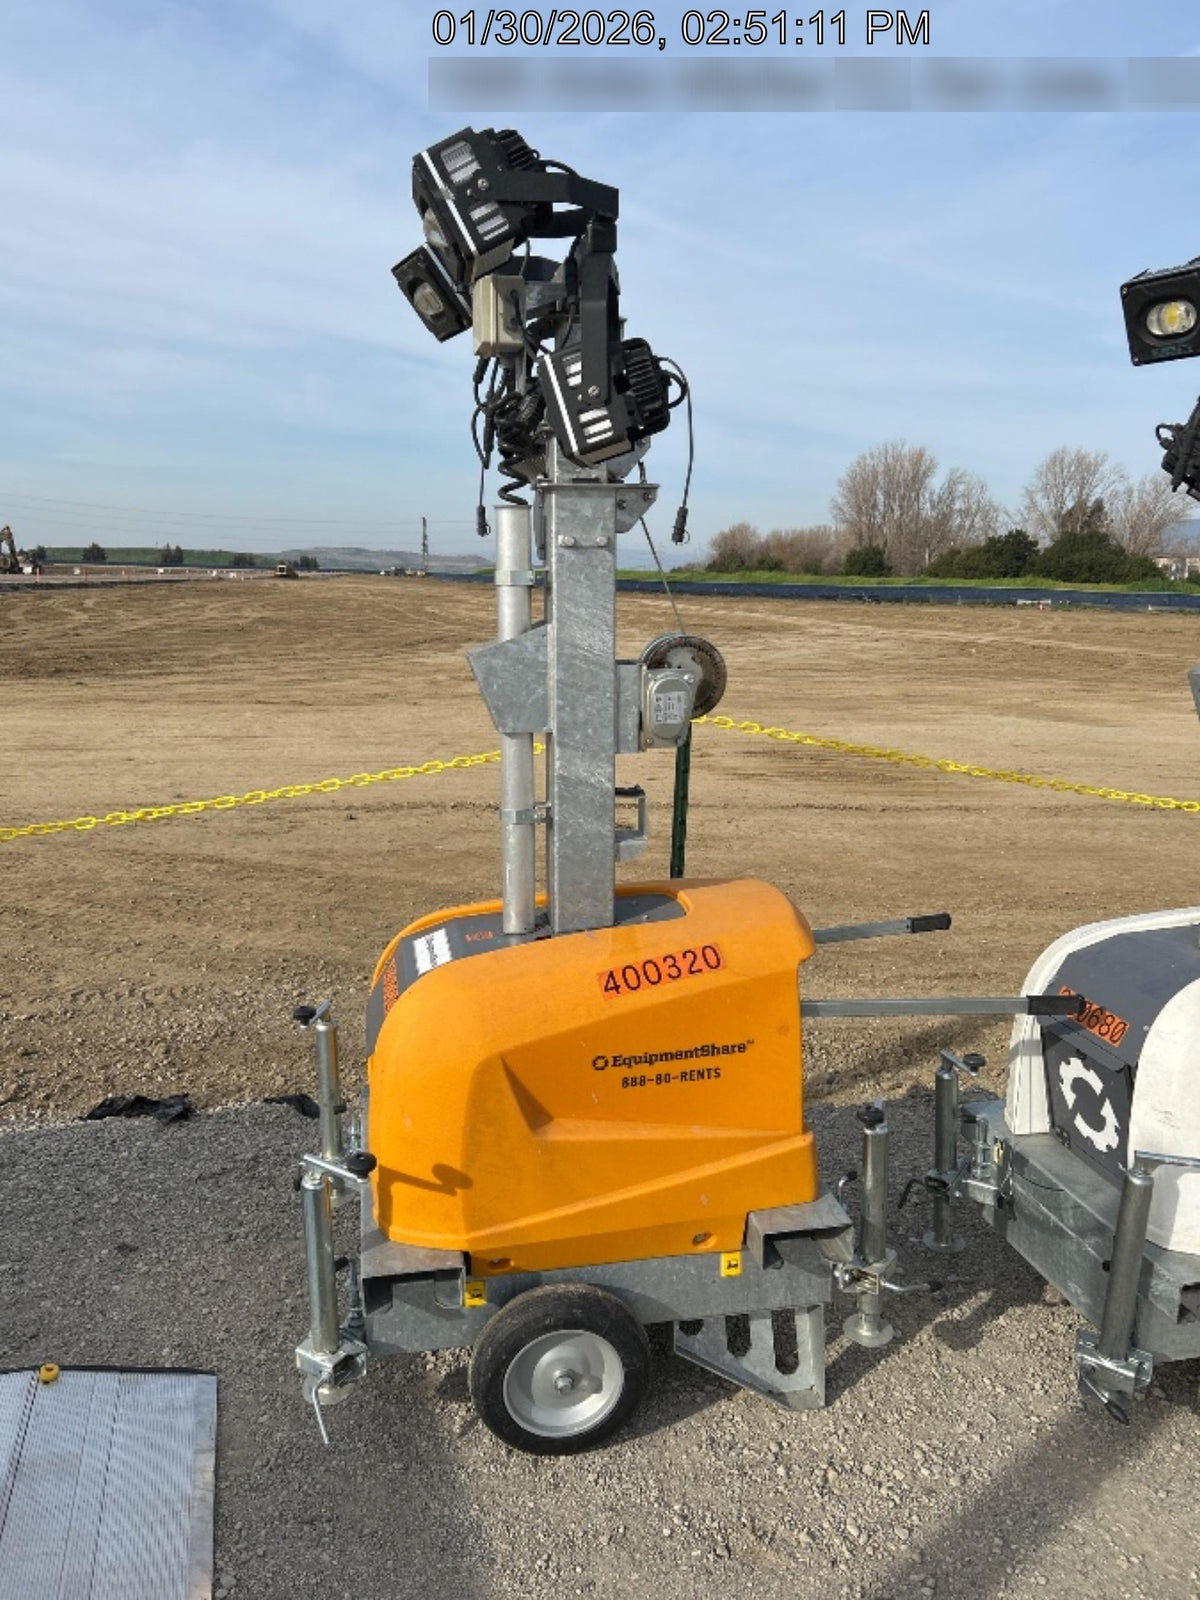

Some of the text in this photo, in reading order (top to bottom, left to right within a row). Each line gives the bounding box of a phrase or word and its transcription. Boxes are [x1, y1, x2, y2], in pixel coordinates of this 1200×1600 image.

[603, 945, 721, 994] 400320
[1061, 988, 1128, 1043] 0680
[621, 1067, 722, 1089] 888-80-RENTS
